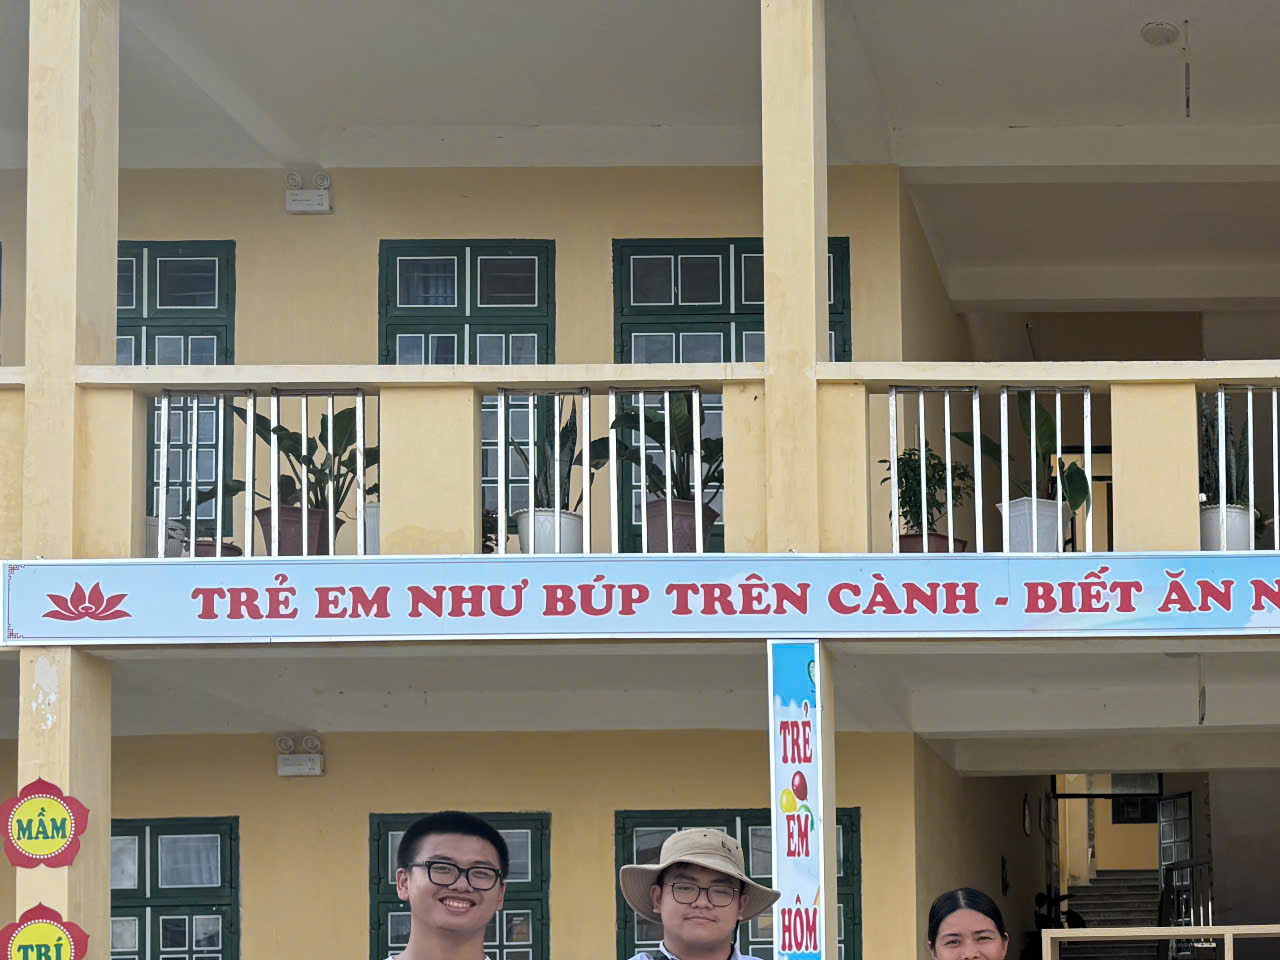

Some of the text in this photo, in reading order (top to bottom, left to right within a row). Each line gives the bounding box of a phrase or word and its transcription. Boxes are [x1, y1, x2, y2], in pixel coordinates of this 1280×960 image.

[191, 574, 298, 620] TRẺ
[314, 586, 391, 619] EM
[407, 578, 530, 618] NHƯ
[542, 574, 649, 616] BÚP
[666, 572, 811, 616] TRÊN
[827, 572, 980, 615] CÀNH
[1023, 565, 1142, 614] BIẾT
[1158, 569, 1235, 613] ĂN
[779, 702, 812, 764] TRẺ
[16, 807, 67, 841] MẦM
[786, 814, 811, 857] EM
[781, 894, 818, 952] HÔM
